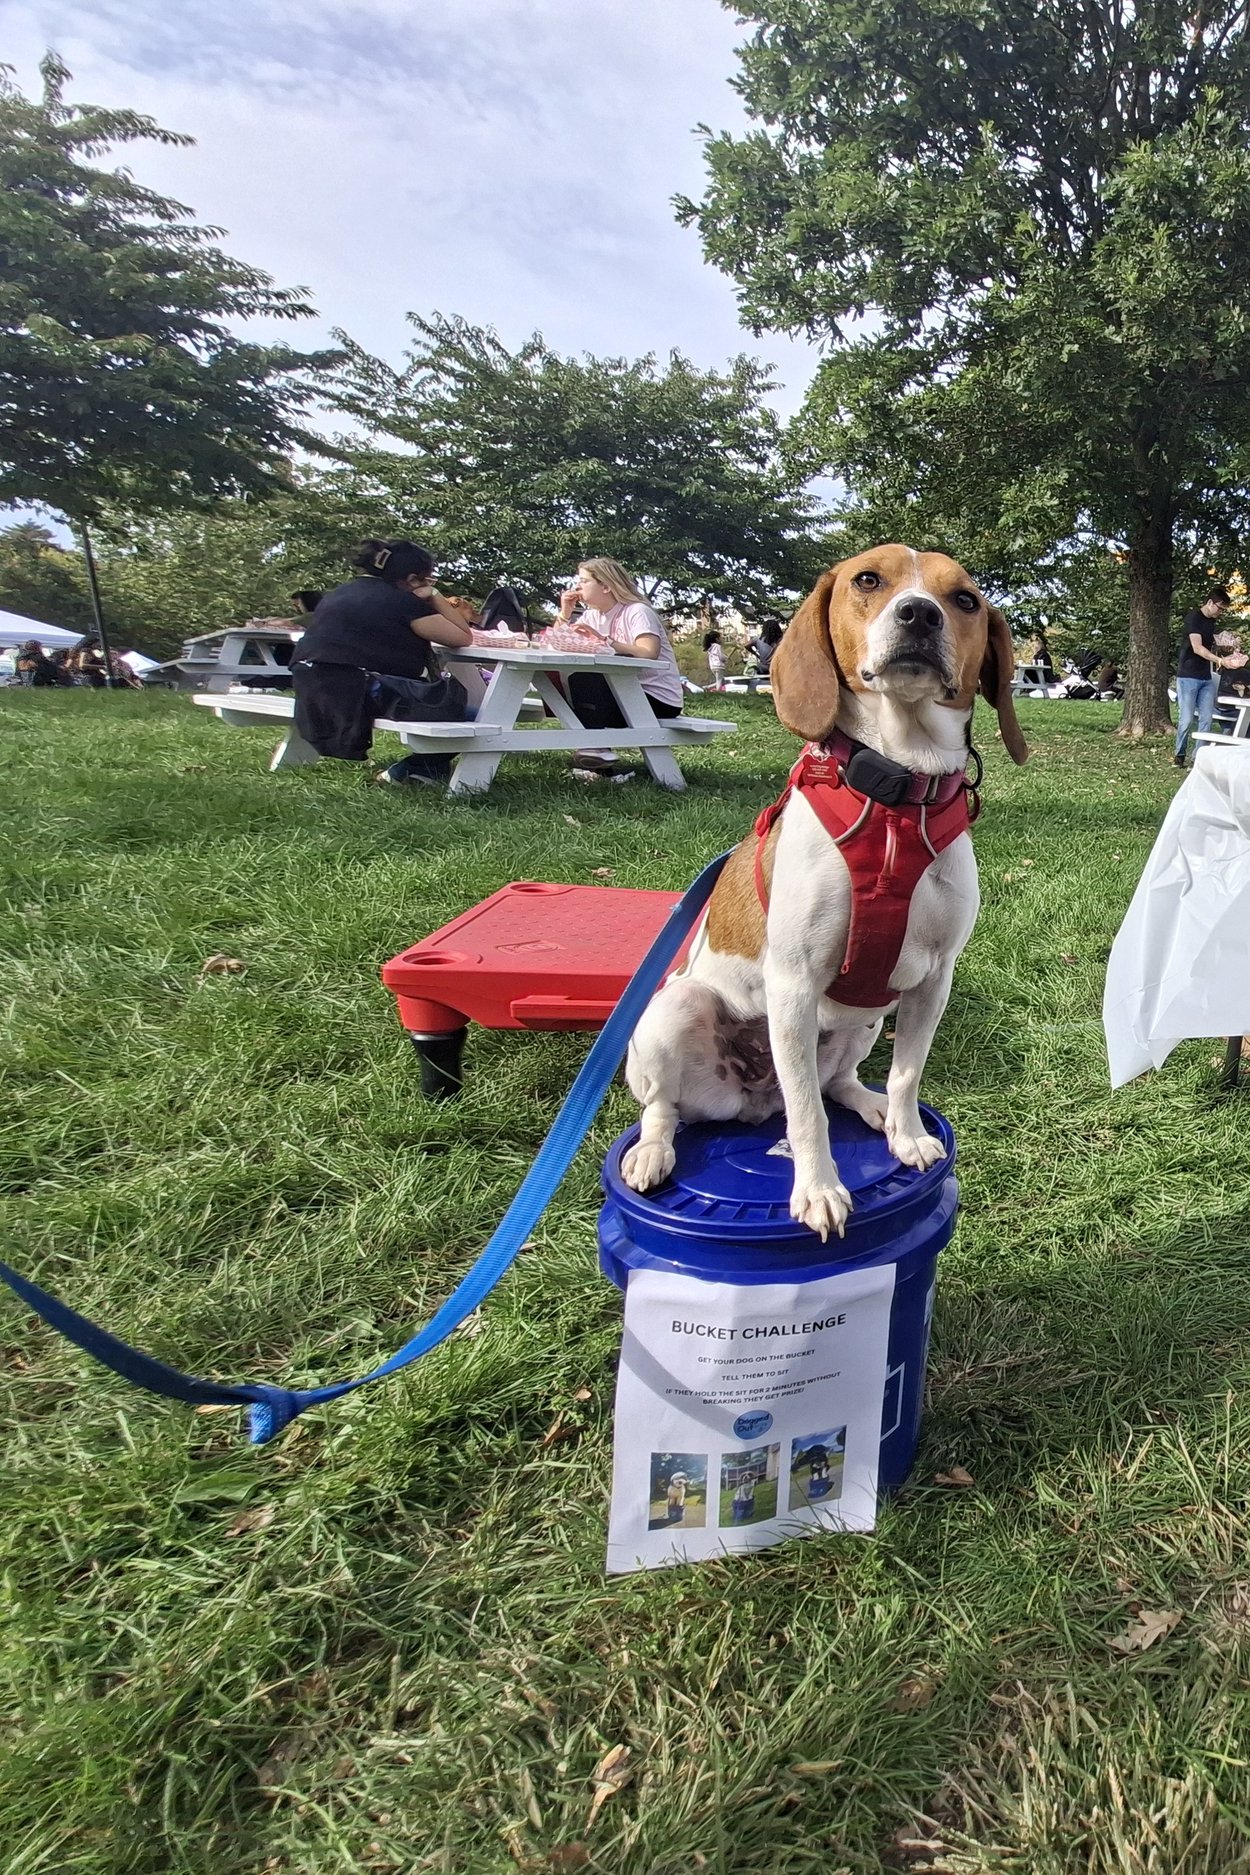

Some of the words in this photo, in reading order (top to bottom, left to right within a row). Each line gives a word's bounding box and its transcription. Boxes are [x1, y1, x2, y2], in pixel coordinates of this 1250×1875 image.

[672, 1320, 737, 1340] BUCKET
[742, 1313, 847, 1339] CHALLENGE
[786, 1349, 815, 1359] BUCKET
[749, 1387, 764, 1395] FOR
[772, 1380, 806, 1392] MINUTES
[807, 1371, 841, 1384] WITHOUT
[744, 1395, 764, 1403] THEY
[781, 1387, 805, 1397] PRIZE!
[738, 1413, 770, 1426] Dogged
[737, 1424, 753, 1432] Out
